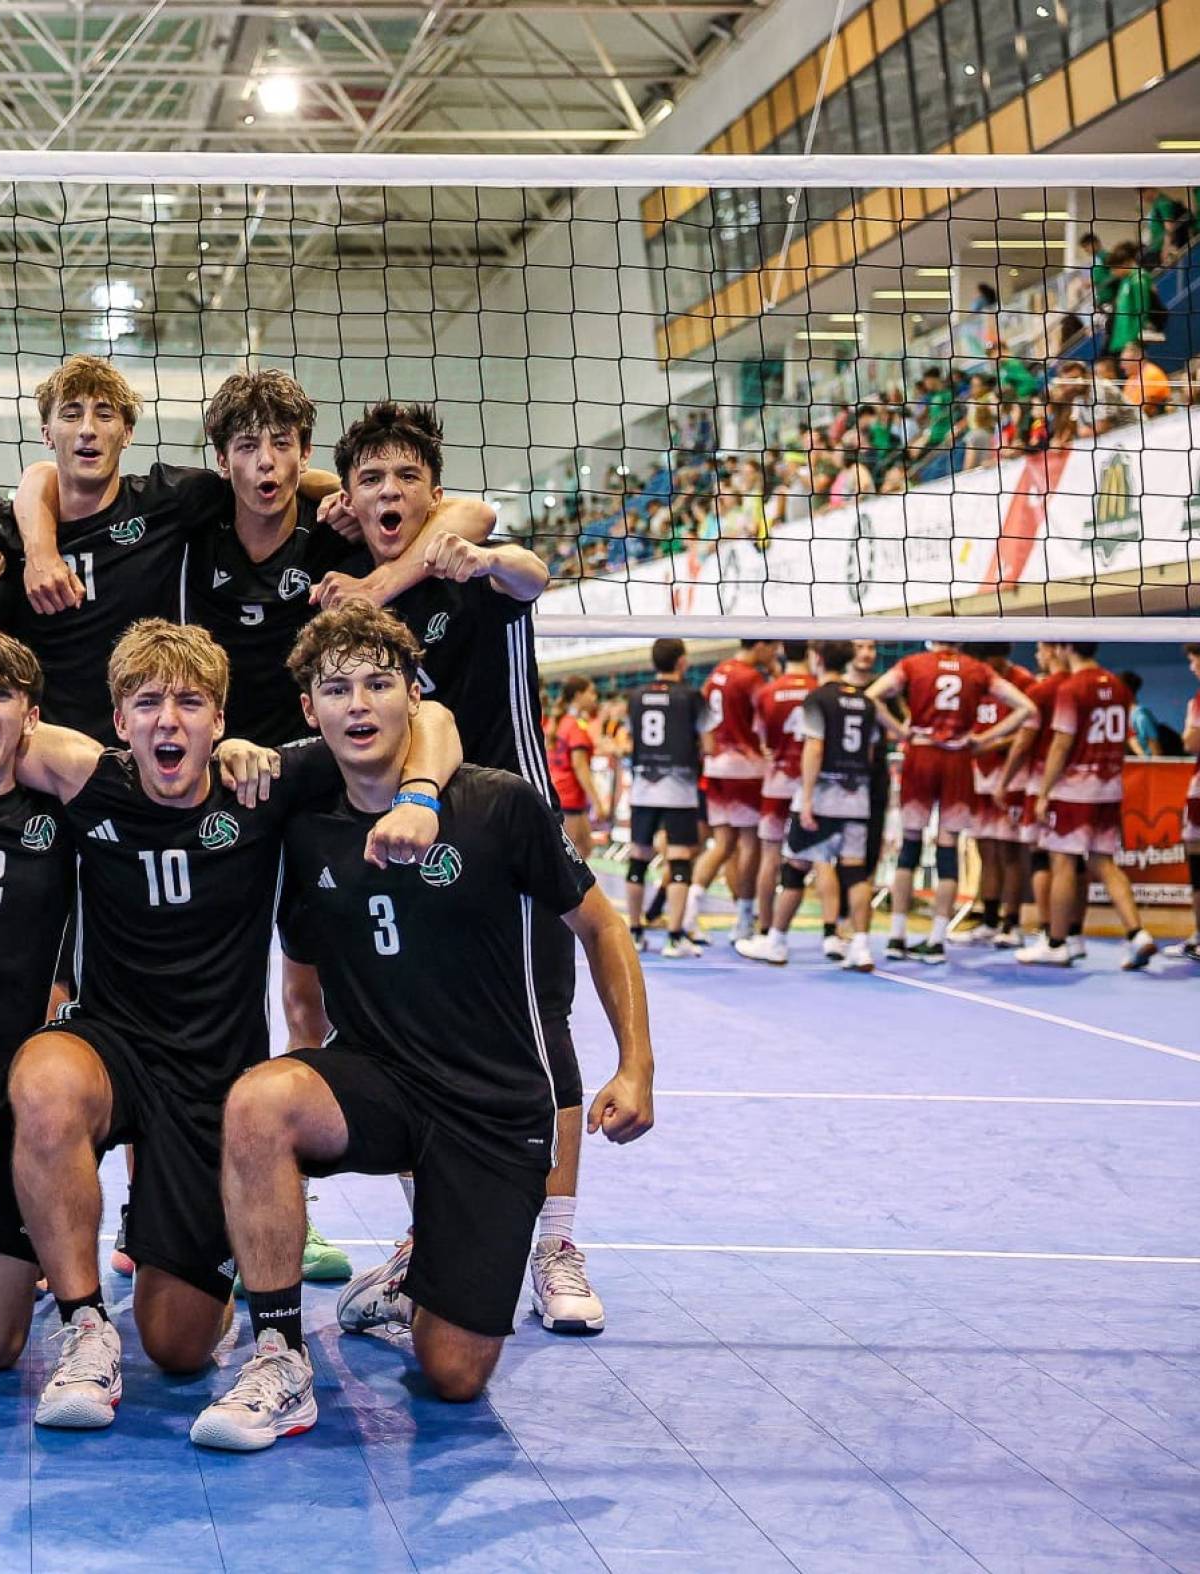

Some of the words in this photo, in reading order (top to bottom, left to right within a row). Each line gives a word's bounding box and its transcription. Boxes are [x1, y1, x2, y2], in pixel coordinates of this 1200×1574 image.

[63, 552, 96, 601] 1
[934, 674, 963, 711] 2
[641, 709, 666, 747] 8
[842, 714, 864, 753] 5
[1087, 704, 1126, 744] 20
[138, 849, 191, 906] 10
[368, 894, 400, 956] 3
